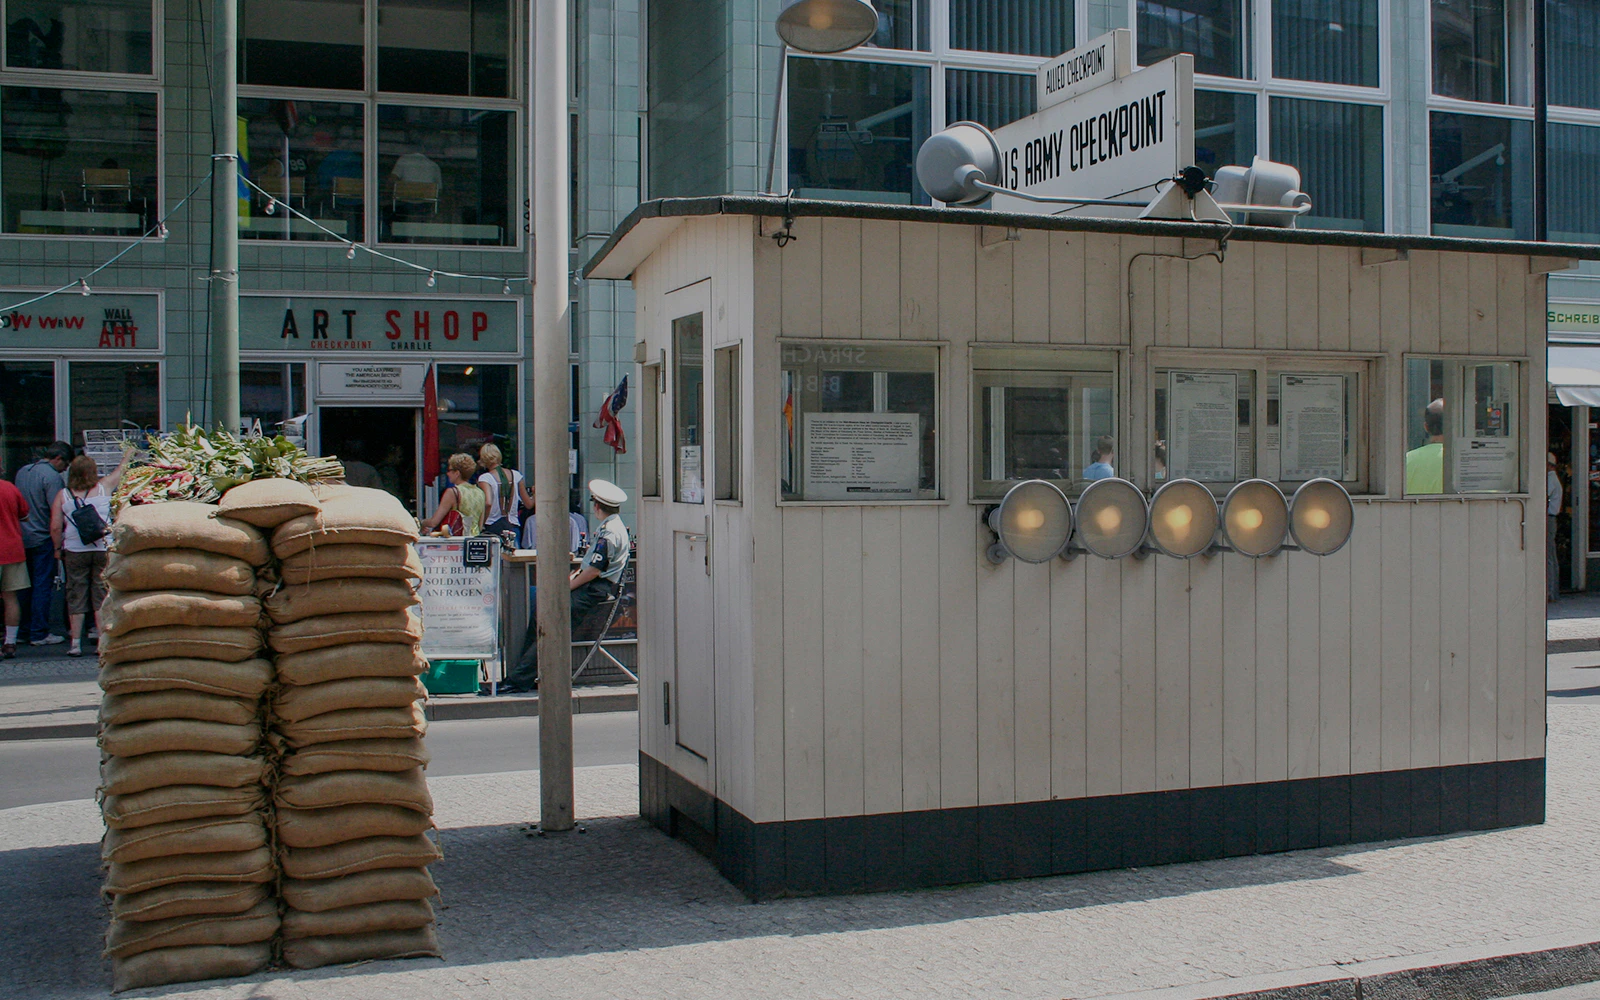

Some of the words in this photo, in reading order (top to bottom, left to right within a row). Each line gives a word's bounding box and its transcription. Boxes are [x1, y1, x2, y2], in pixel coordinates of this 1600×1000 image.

[1045, 69, 1065, 95] ALLIED
[1067, 44, 1106, 86] CHECKPOINT
[1025, 130, 1063, 187] ARMY
[1070, 90, 1166, 171] CHECKPOINT
[104, 308, 132, 319] WALL
[280, 309, 357, 339] ART
[385, 310, 488, 341] SHOP
[98, 326, 138, 347] ART
[311, 340, 373, 349] CHECKPOINT
[391, 341, 432, 350] CHARLIE
[424, 567, 448, 575] ITTE
[425, 578, 482, 586] SOLDATEN
[424, 588, 483, 597] ANFRAGEN
